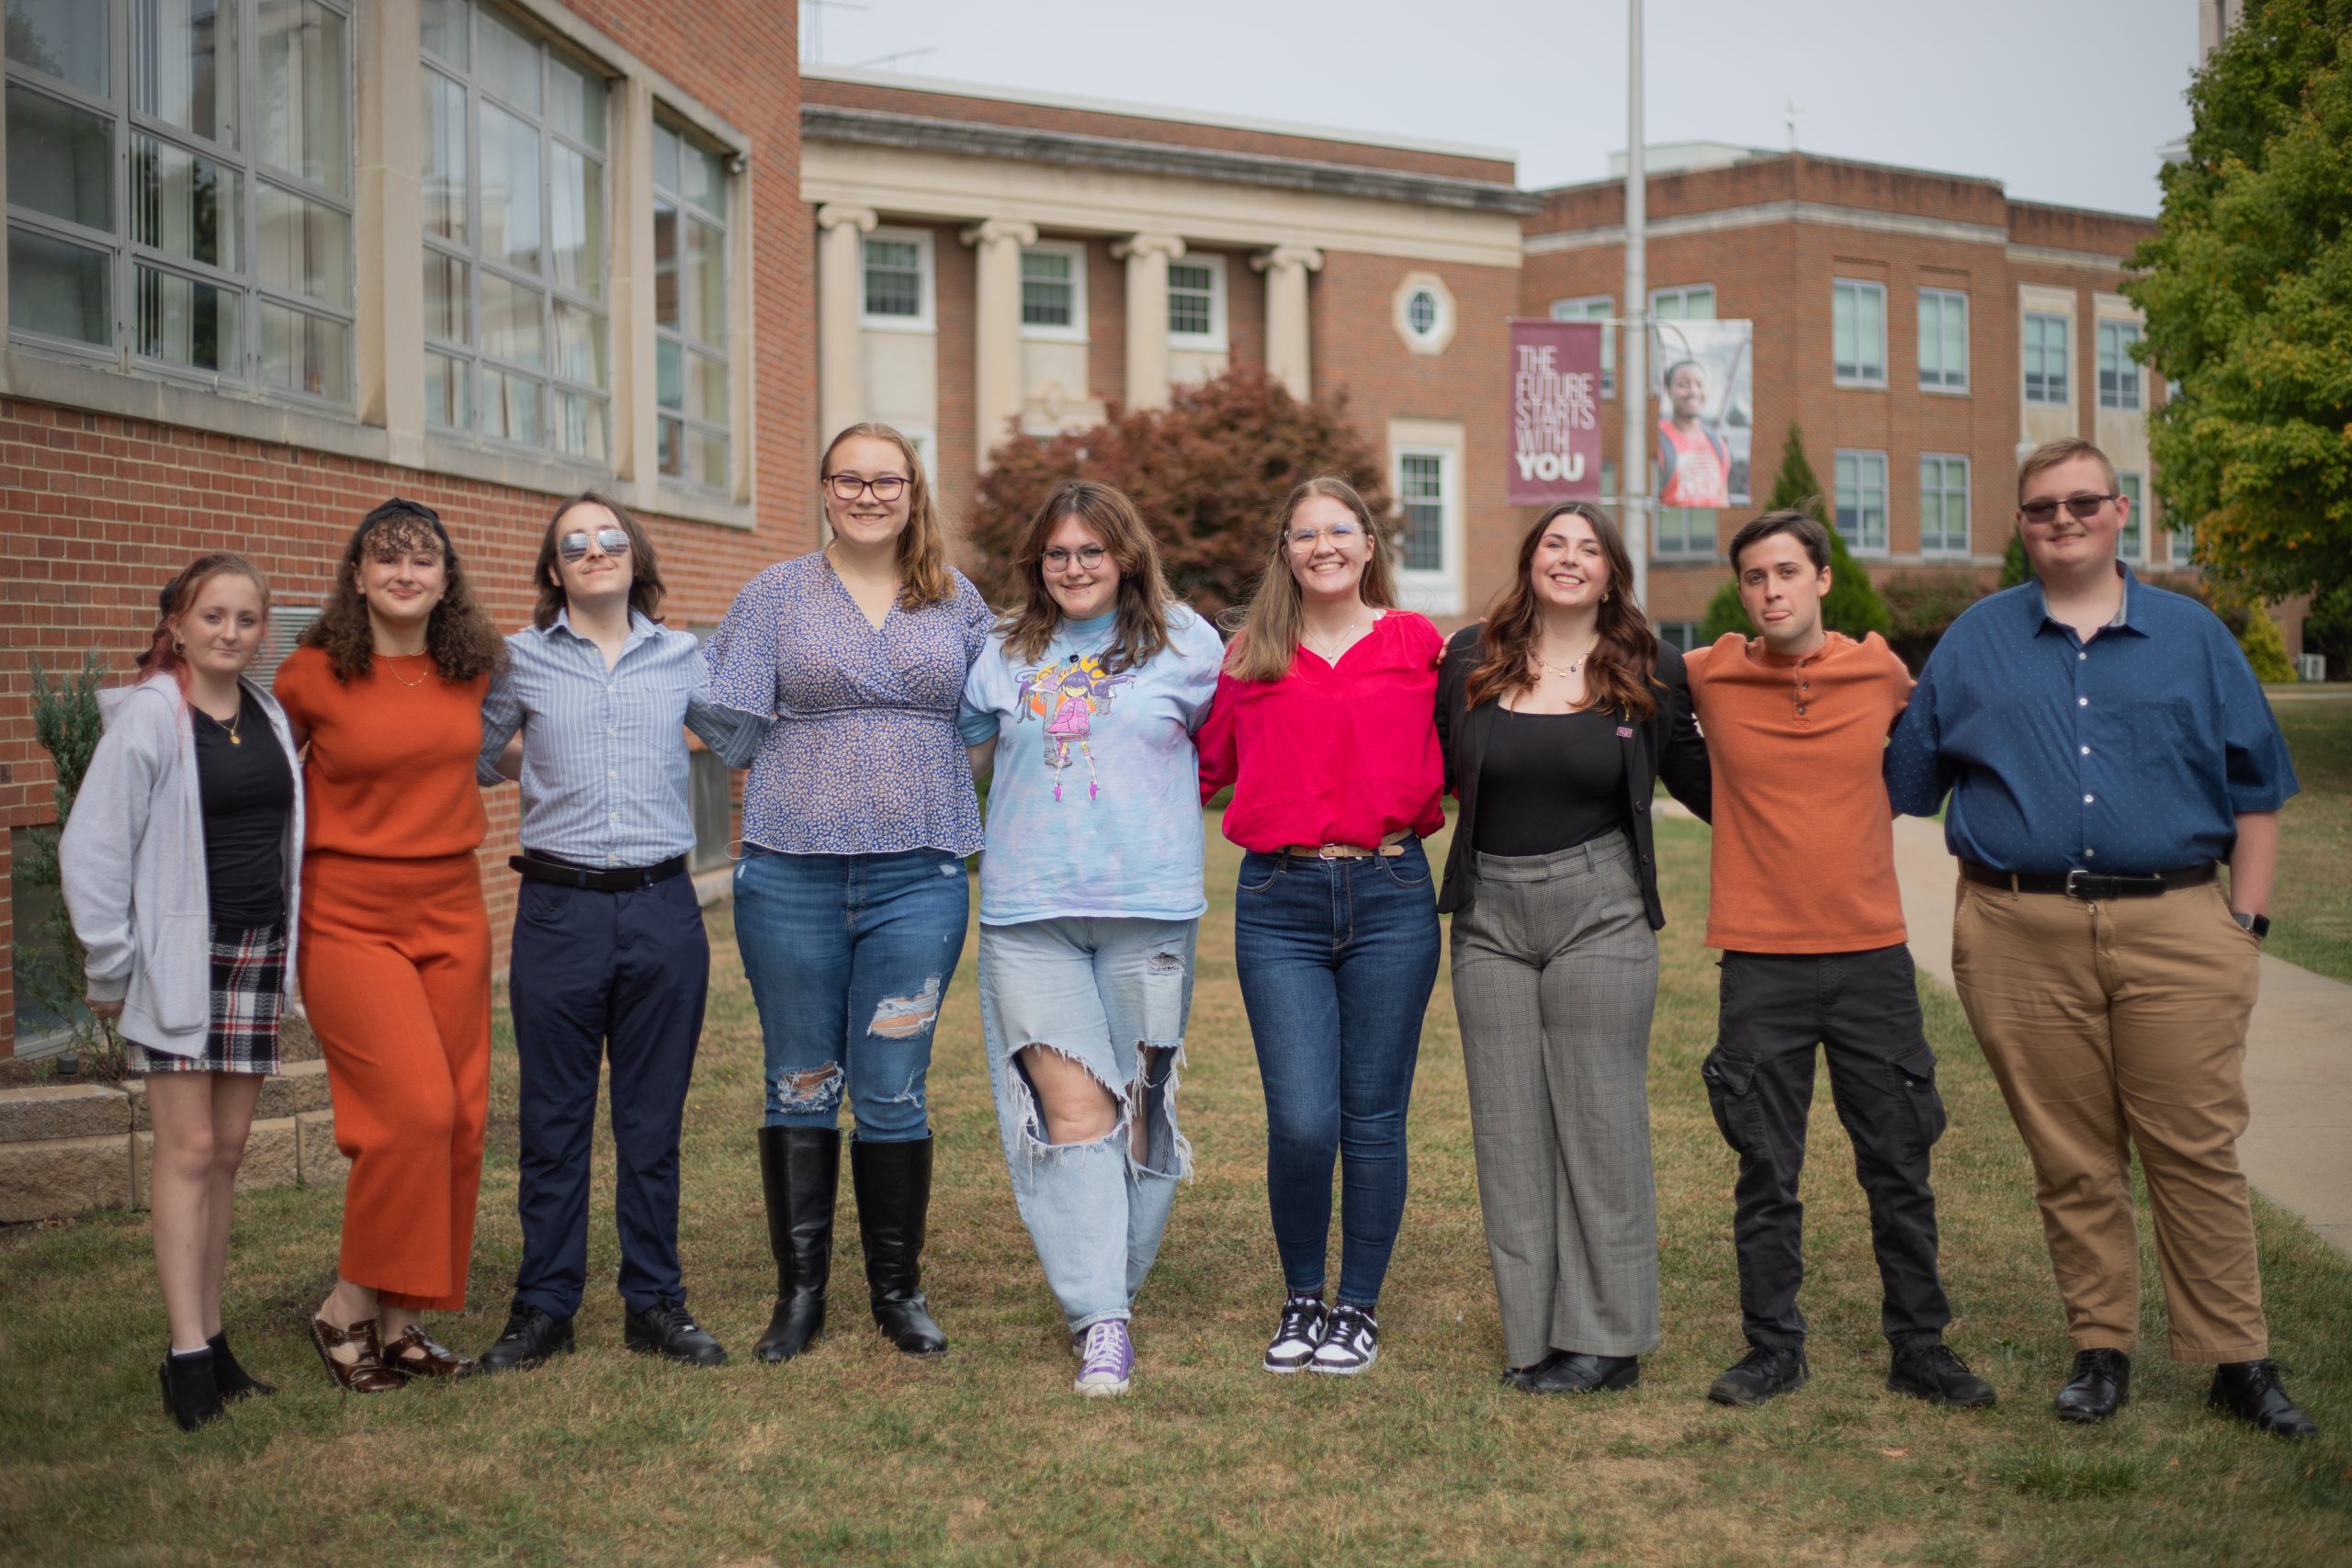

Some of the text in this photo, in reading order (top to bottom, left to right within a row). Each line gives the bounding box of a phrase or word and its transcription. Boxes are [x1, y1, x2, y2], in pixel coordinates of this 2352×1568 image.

[1518, 345, 1558, 373] THE
[1517, 372, 1595, 399] FUTURE
[1516, 398, 1596, 430] STARTS
[1516, 429, 1570, 454] WITH
[1515, 452, 1586, 482] YOU
